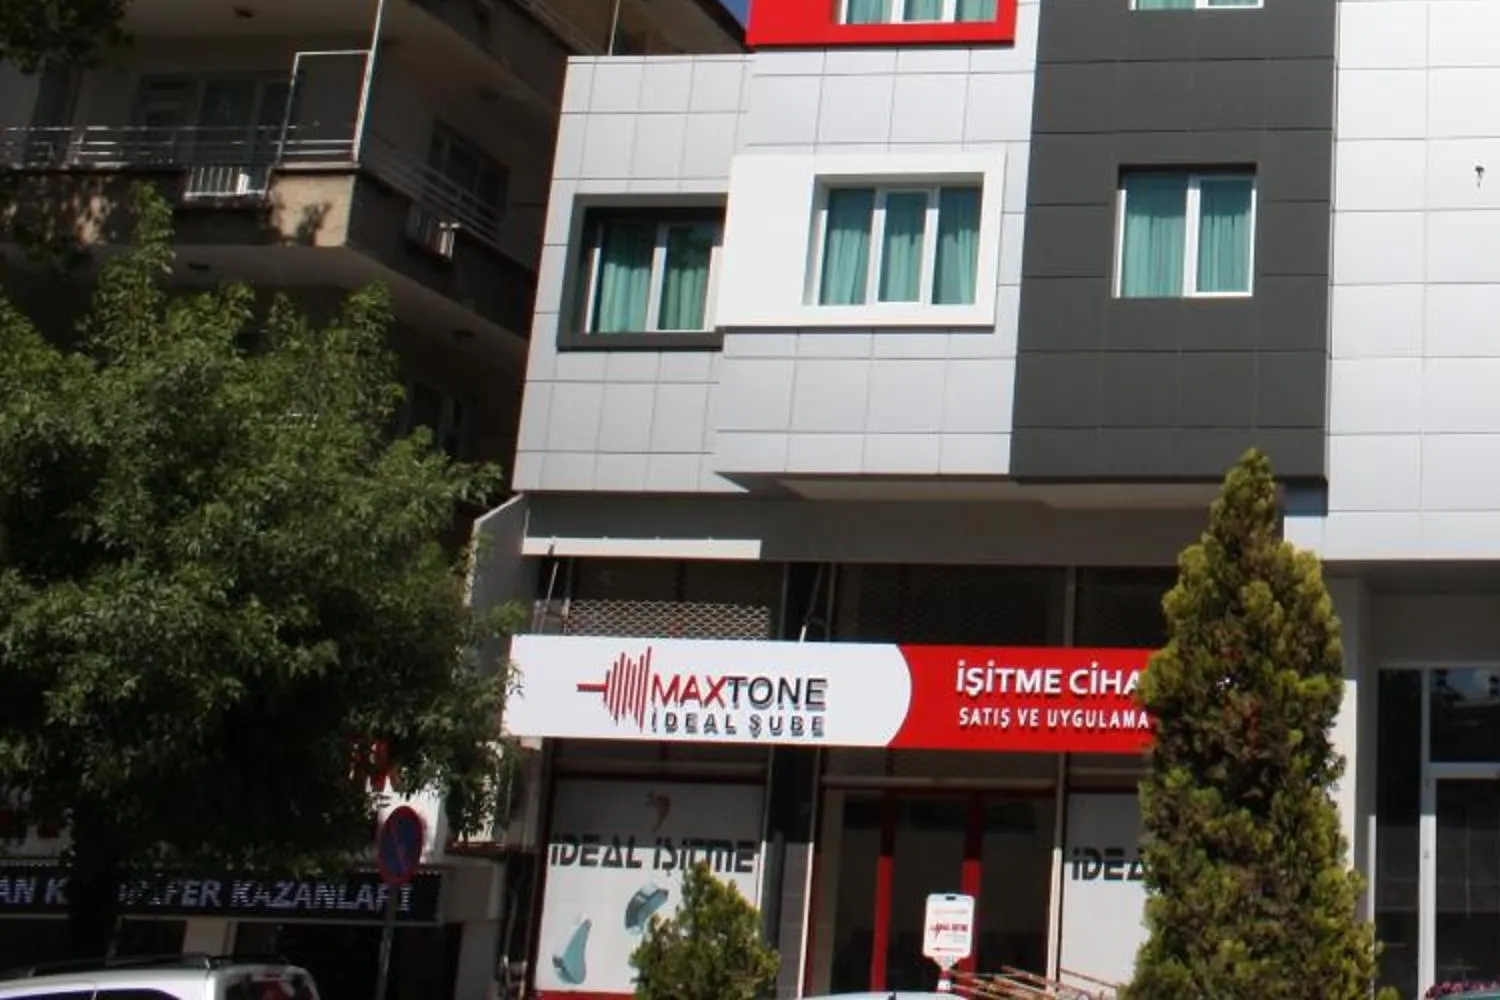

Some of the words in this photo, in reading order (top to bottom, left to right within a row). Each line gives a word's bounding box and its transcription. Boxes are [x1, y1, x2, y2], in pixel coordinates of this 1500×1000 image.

[651, 674, 827, 711] MAXTONE
[956, 659, 1062, 696] İŞİTME
[959, 707, 1011, 729] SATIŞ
[1017, 709, 1040, 727] VE
[1047, 709, 1150, 729] UYGULAMA
